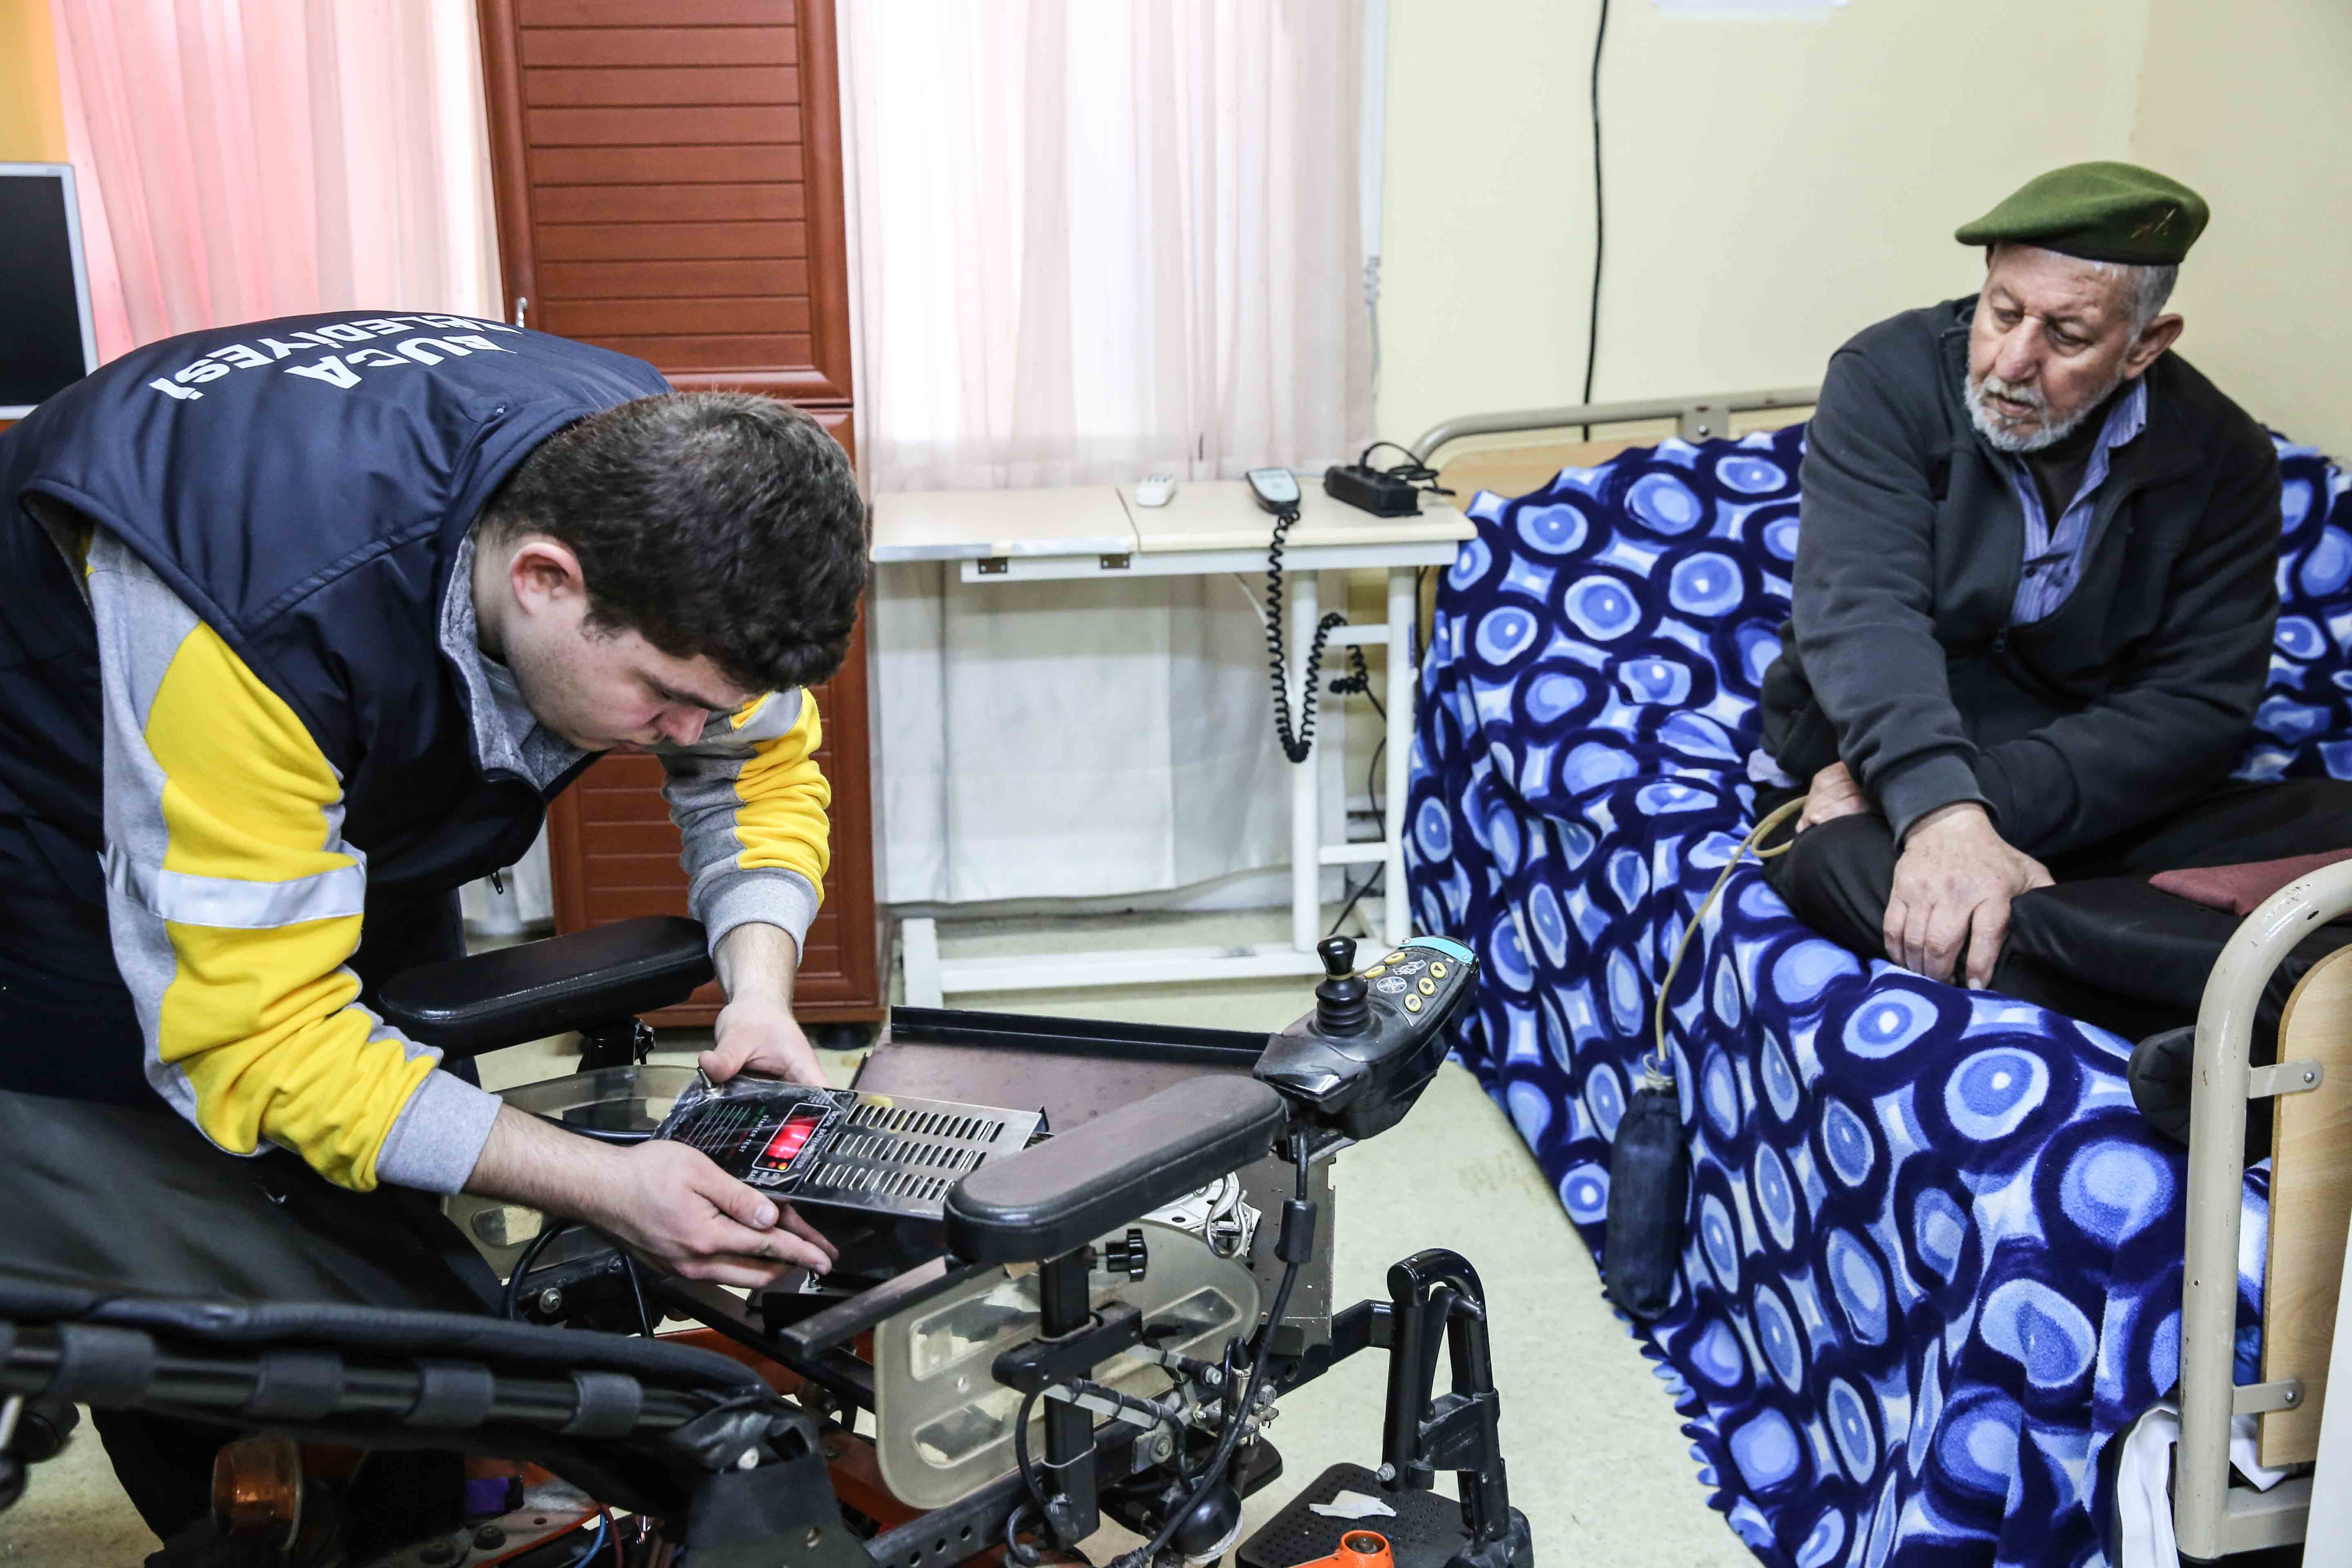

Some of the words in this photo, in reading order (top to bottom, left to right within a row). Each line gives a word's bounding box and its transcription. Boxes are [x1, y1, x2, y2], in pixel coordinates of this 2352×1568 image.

[284, 335, 517, 389] BUCA
[748, 1114, 771, 1138] STARTER
[821, 1111, 840, 1128] DIGITAL
[737, 1138, 753, 1153] TEST
[805, 1128, 827, 1150] BATTER
